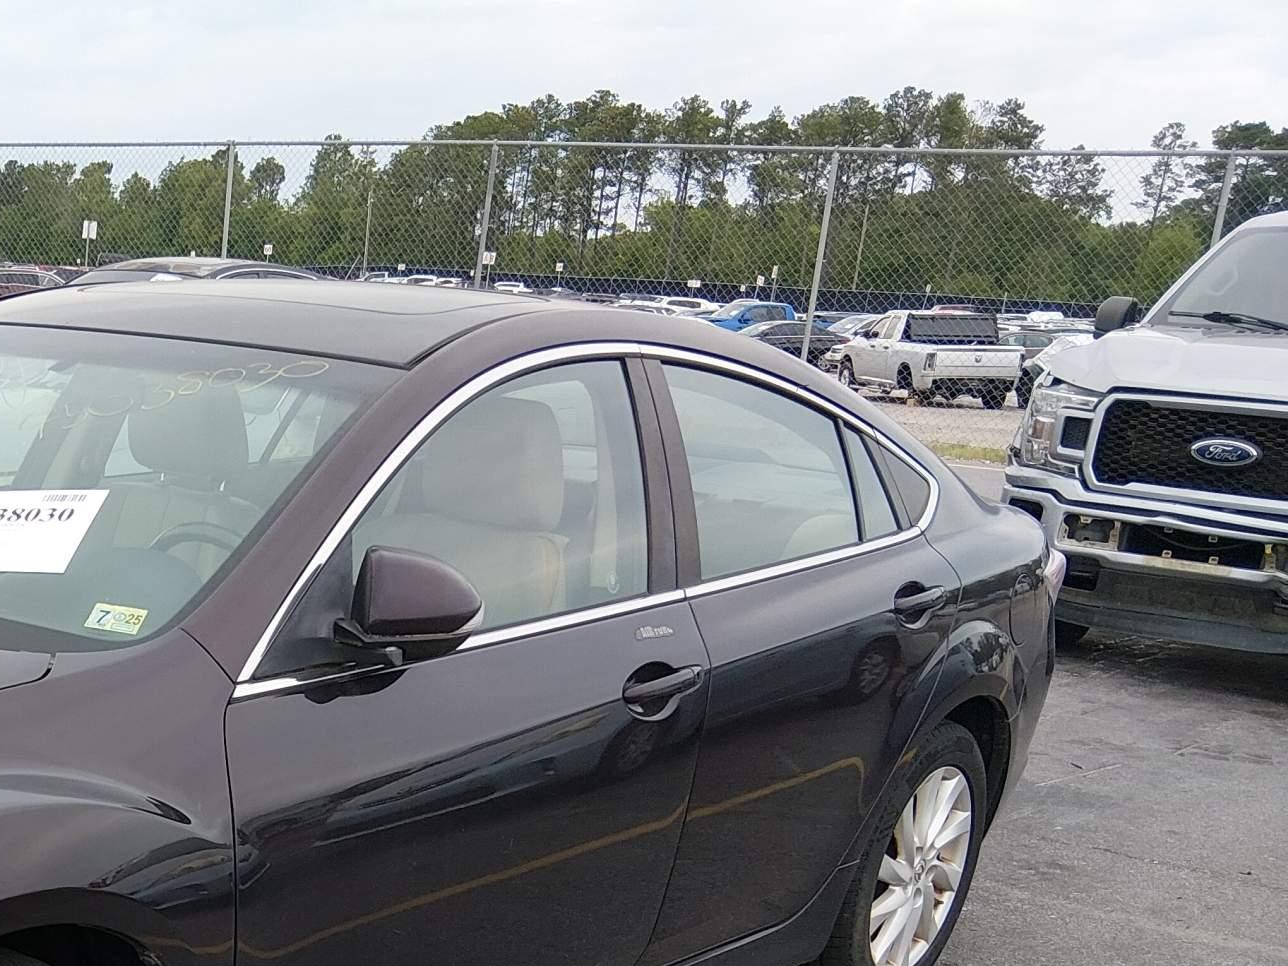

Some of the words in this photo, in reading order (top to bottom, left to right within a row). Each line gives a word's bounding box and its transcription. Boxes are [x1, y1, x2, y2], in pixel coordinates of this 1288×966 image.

[1205, 445, 1242, 460] Ford
[96, 609, 111, 624] 7
[125, 613, 143, 626] 25
